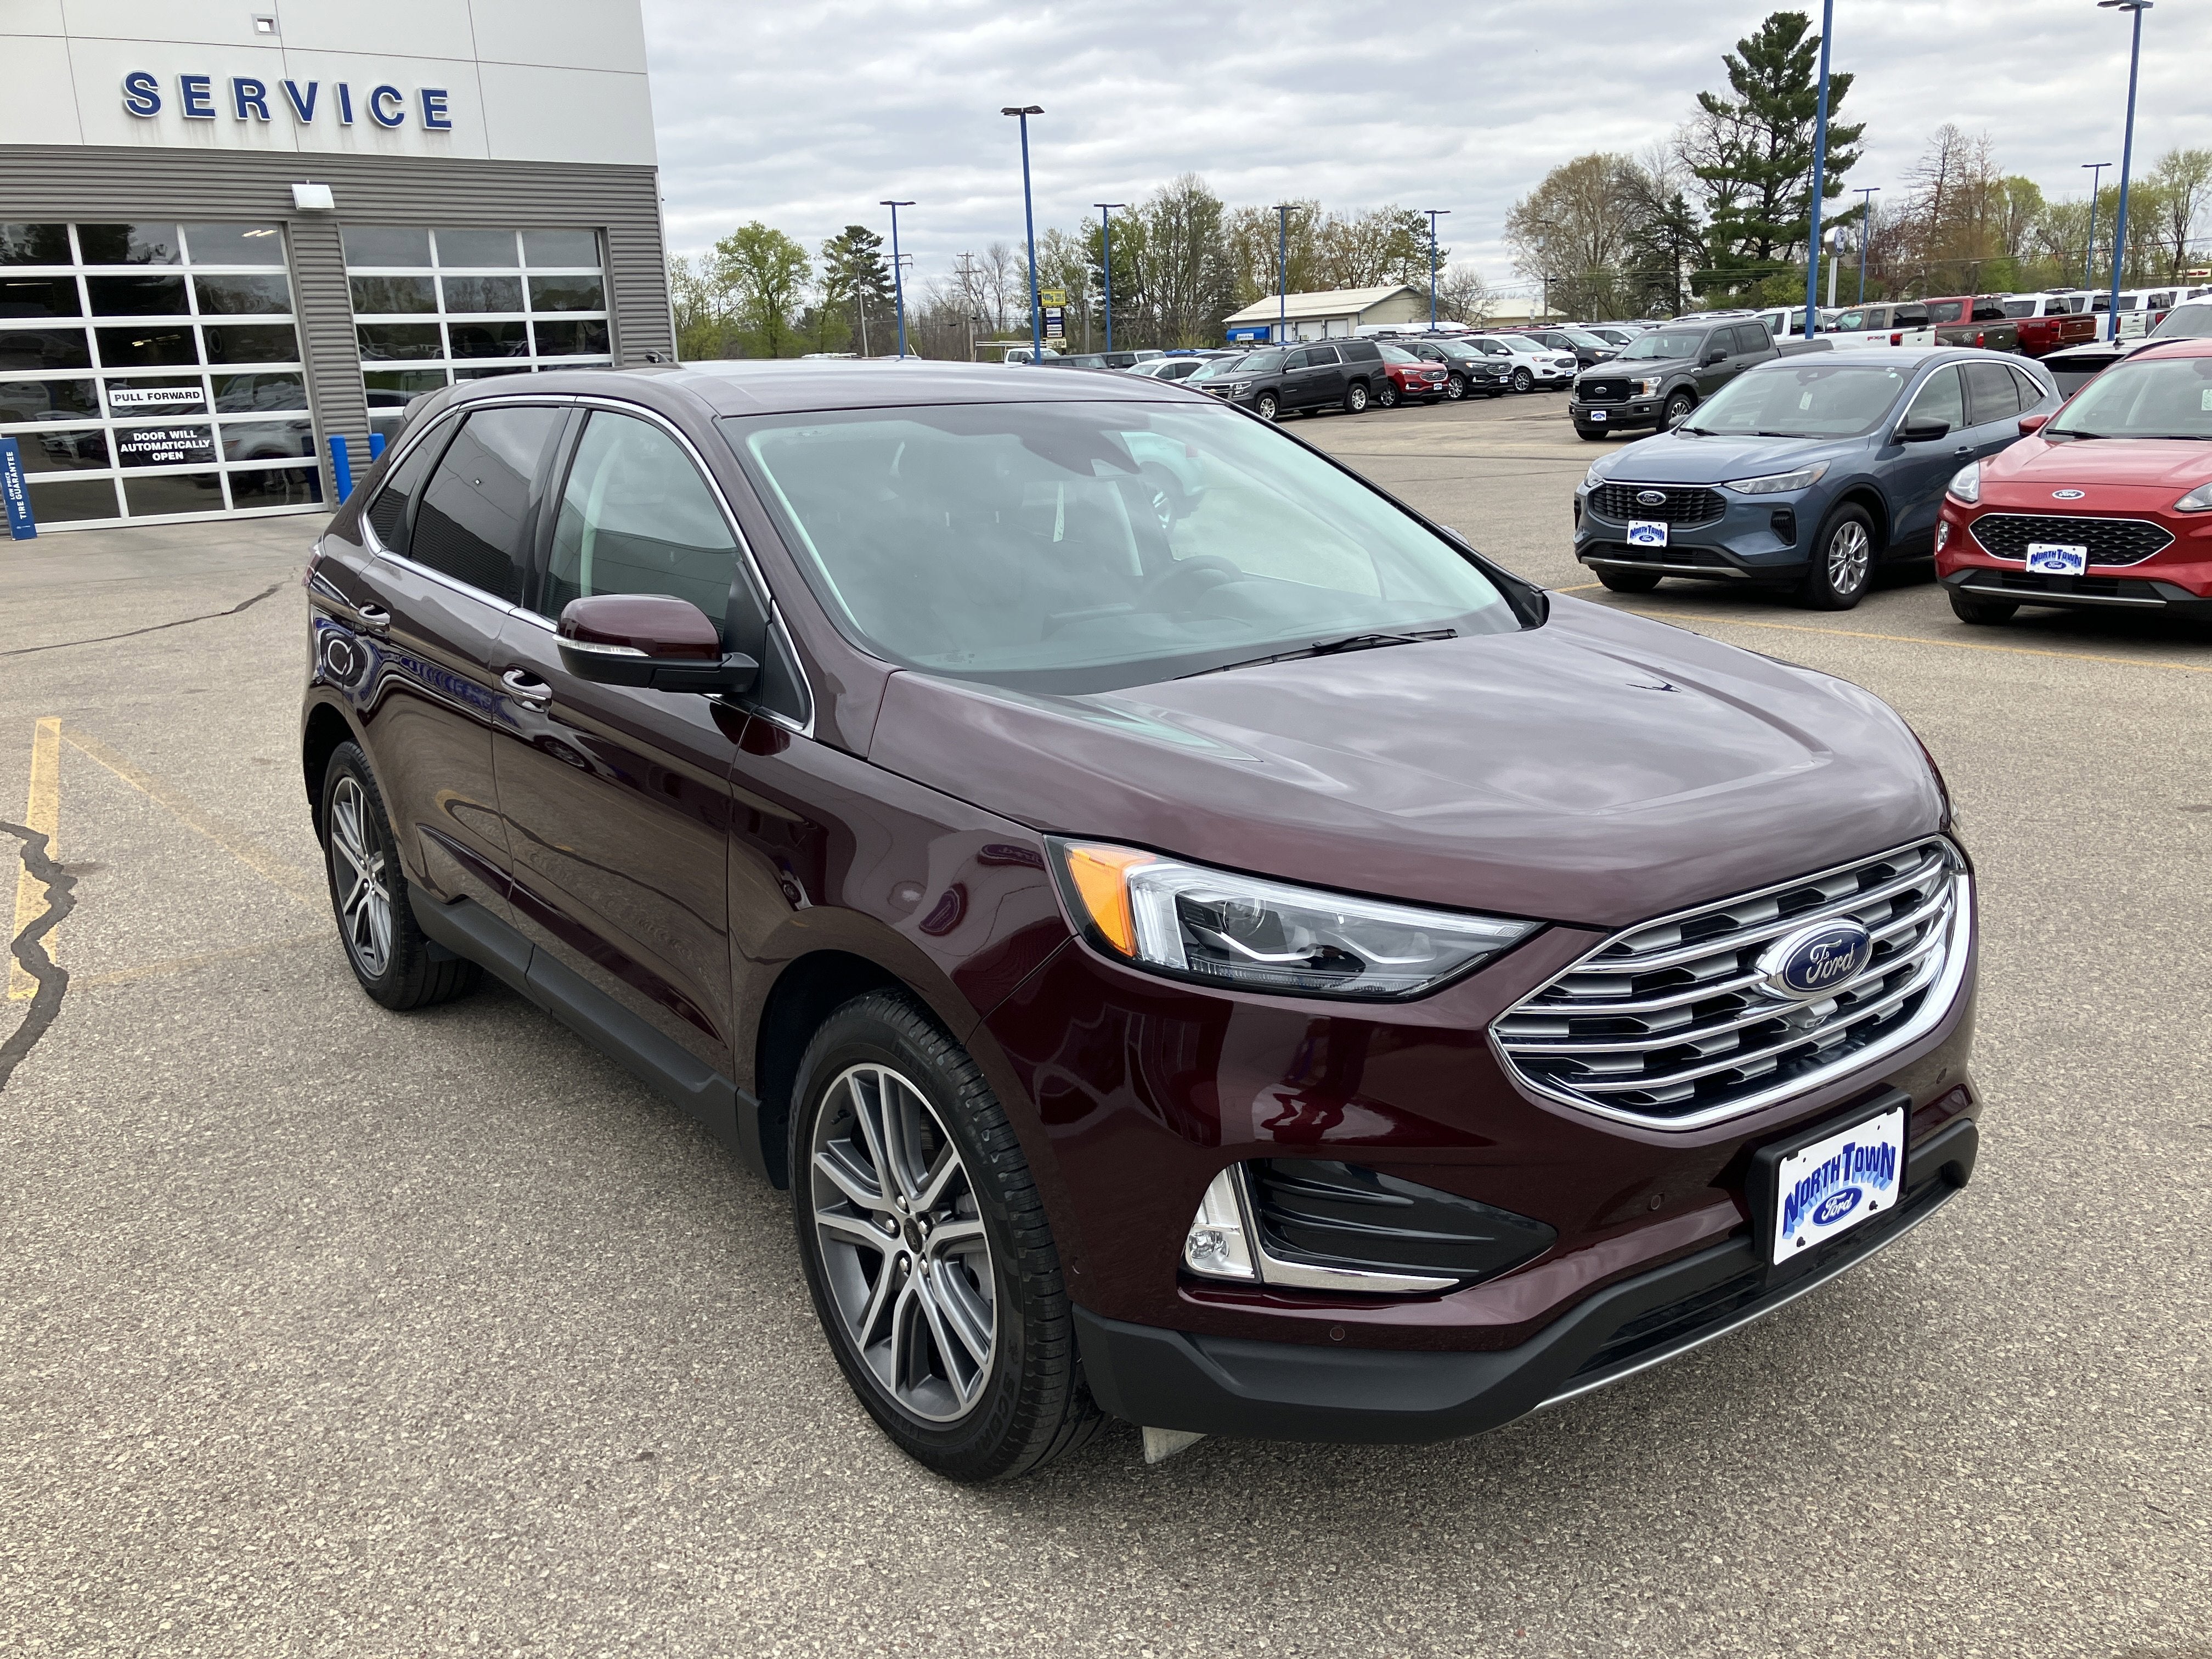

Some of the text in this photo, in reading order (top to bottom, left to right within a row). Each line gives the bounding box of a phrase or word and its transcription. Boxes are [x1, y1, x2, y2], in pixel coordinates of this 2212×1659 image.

[123, 70, 452, 131] SERVICE
[114, 392, 200, 402] PULL FORWARD
[133, 430, 197, 441] DOOR WILL
[121, 440, 210, 453] AUTOMATICALLY
[152, 452, 184, 461] OPEN
[6, 451, 22, 500] GUARANTEE
[1642, 494, 1659, 502] Ford
[17, 501, 26, 520] TIRE
[1806, 939, 1855, 984] Ford
[1820, 1192, 1854, 1221] Ford
